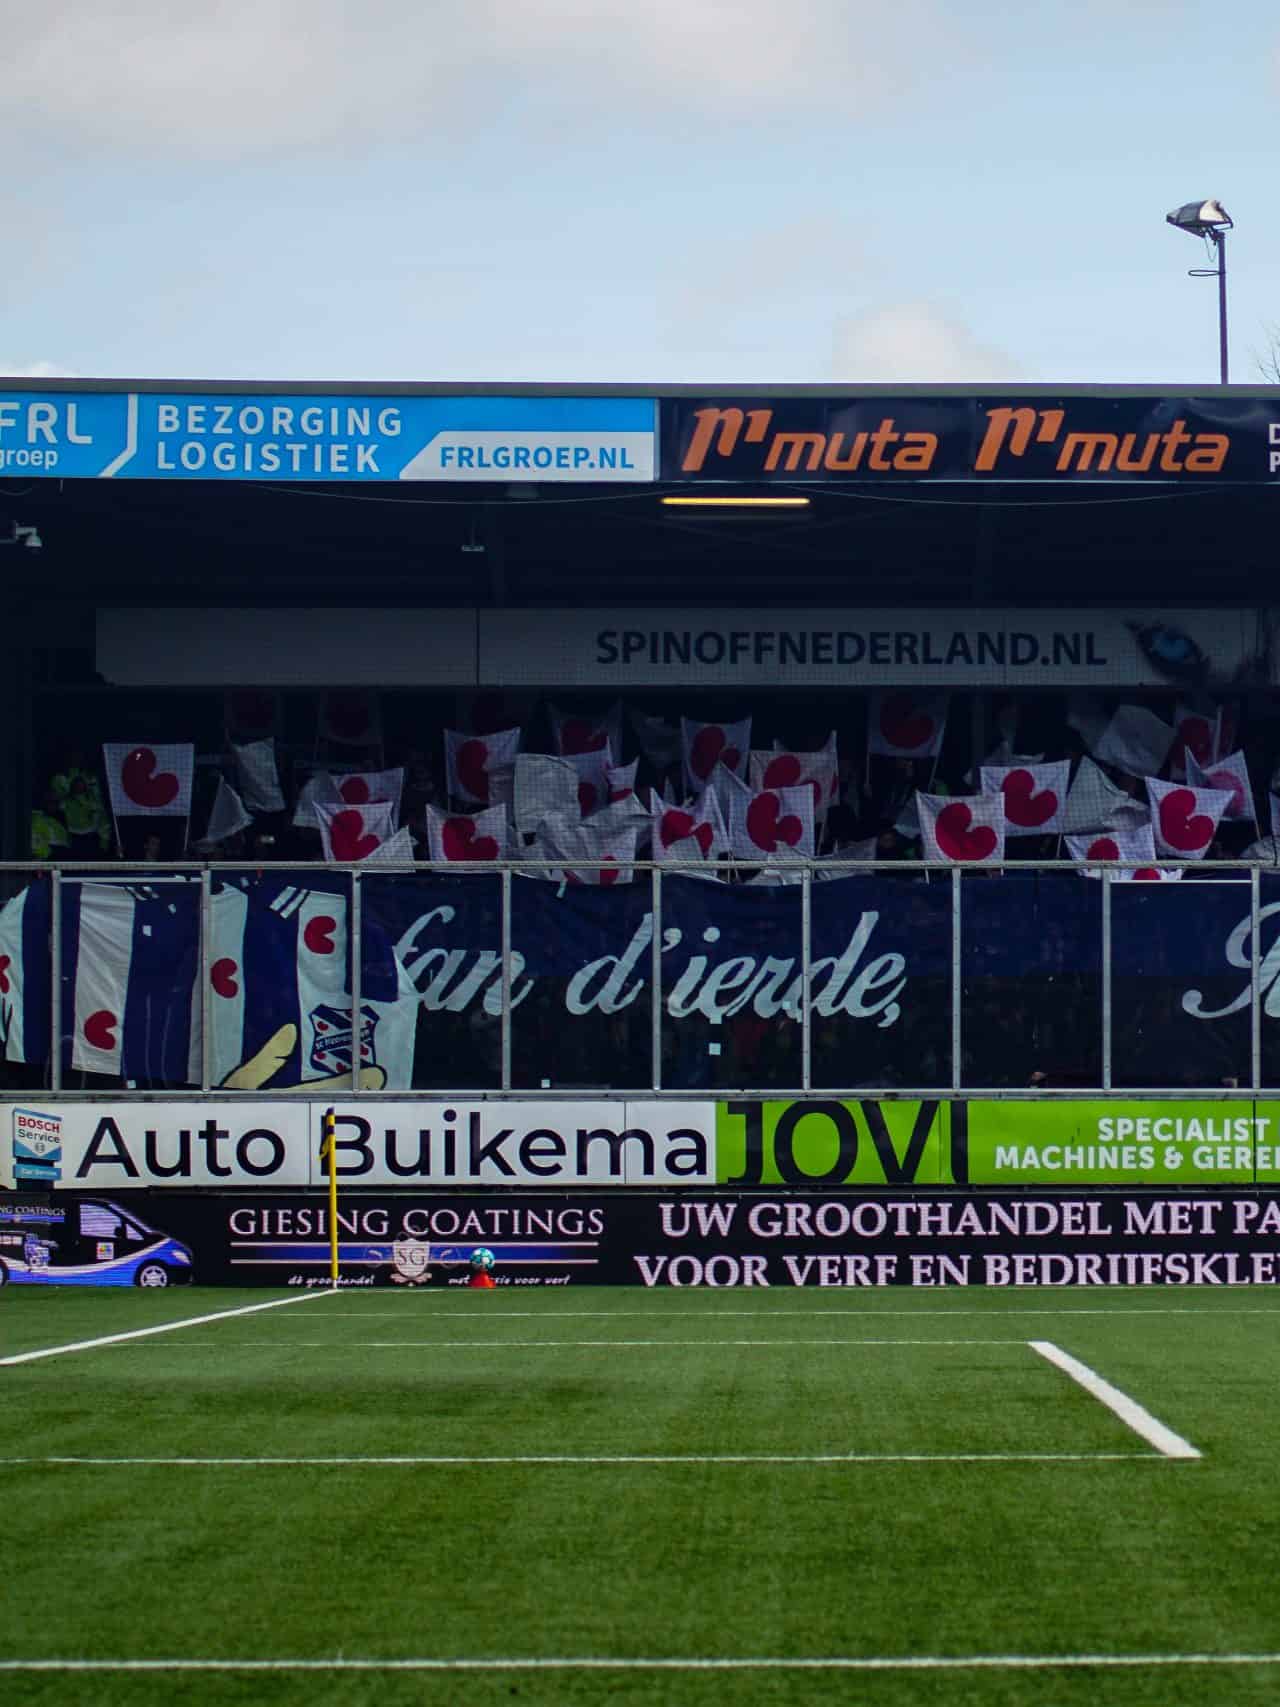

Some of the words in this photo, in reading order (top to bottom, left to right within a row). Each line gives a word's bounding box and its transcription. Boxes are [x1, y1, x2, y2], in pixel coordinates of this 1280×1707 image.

[158, 404, 401, 437] BEZORGING
[158, 441, 380, 474] LOGISTIEK
[441, 445, 634, 469] FRLGROEP.NL
[764, 419, 938, 472] muta
[1056, 420, 1230, 472] muta
[595, 630, 1107, 665] SPINOFFNEDERLAND.NL
[392, 905, 534, 1016] fan
[18, 1115, 60, 1133] BOSCH
[18, 1128, 61, 1144] Service
[1098, 1117, 1270, 1142] SPECIALIST
[75, 1116, 286, 1178] Auto
[320, 1109, 708, 1177] Buikema
[728, 1100, 968, 1185] JOVI
[994, 1145, 1155, 1170] MACHINES
[1163, 1146, 1184, 1170] &
[229, 1208, 390, 1235] GIESING
[402, 1208, 604, 1235] COATINGS
[659, 1202, 738, 1238] UW
[749, 1202, 1112, 1238] GROOTHANDEL
[1123, 1200, 1223, 1236] MET
[633, 1254, 771, 1288] VOOR
[782, 1254, 898, 1287] VERF
[910, 1254, 972, 1287] EN
